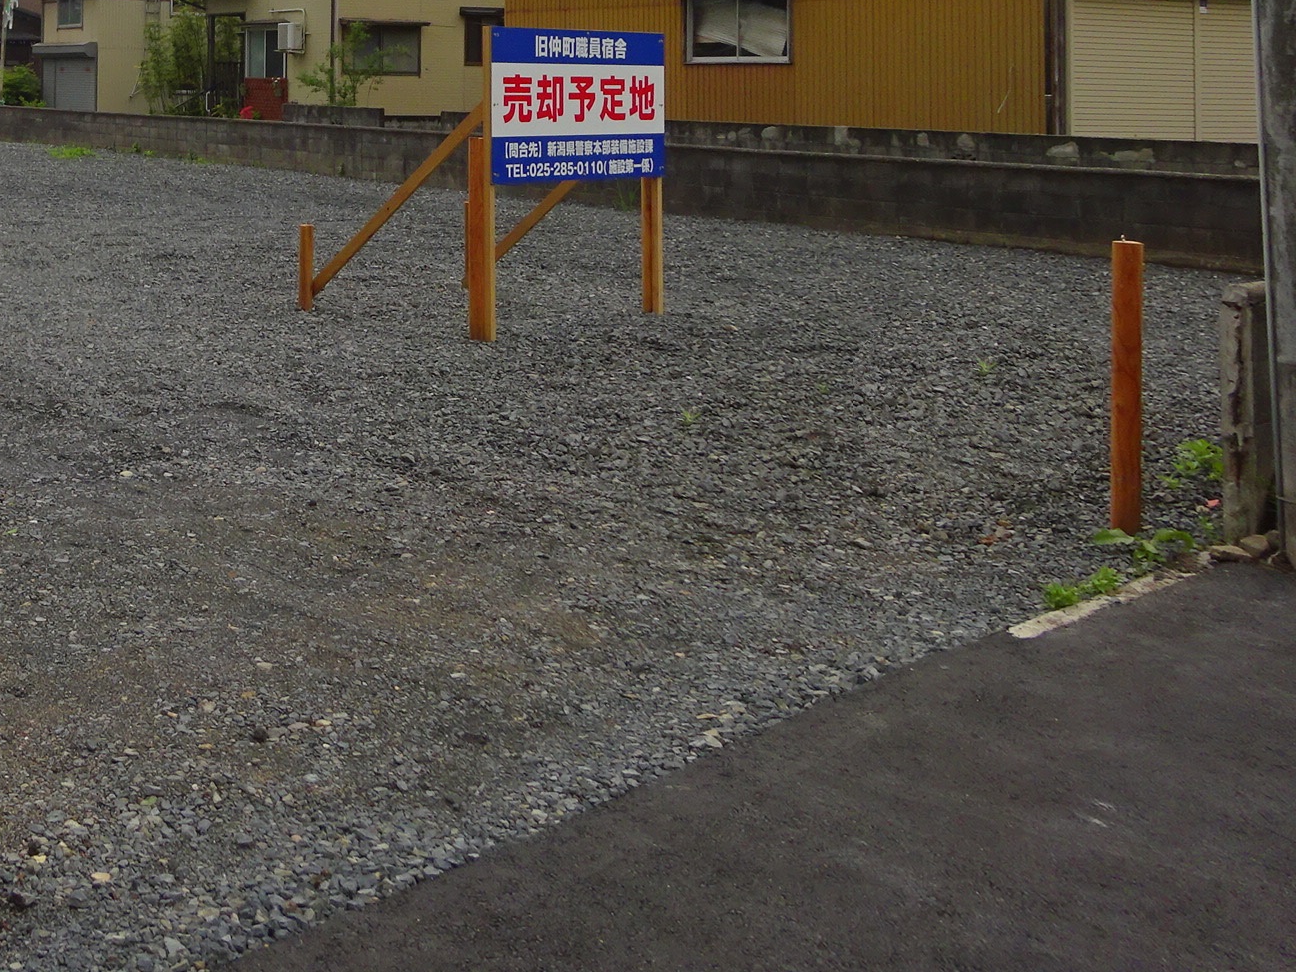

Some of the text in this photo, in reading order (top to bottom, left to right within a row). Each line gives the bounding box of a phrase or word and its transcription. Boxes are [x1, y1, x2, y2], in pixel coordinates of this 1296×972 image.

[535, 35, 627, 59] 旧仲町職員宿舎
[503, 74, 655, 123] 売却予定地
